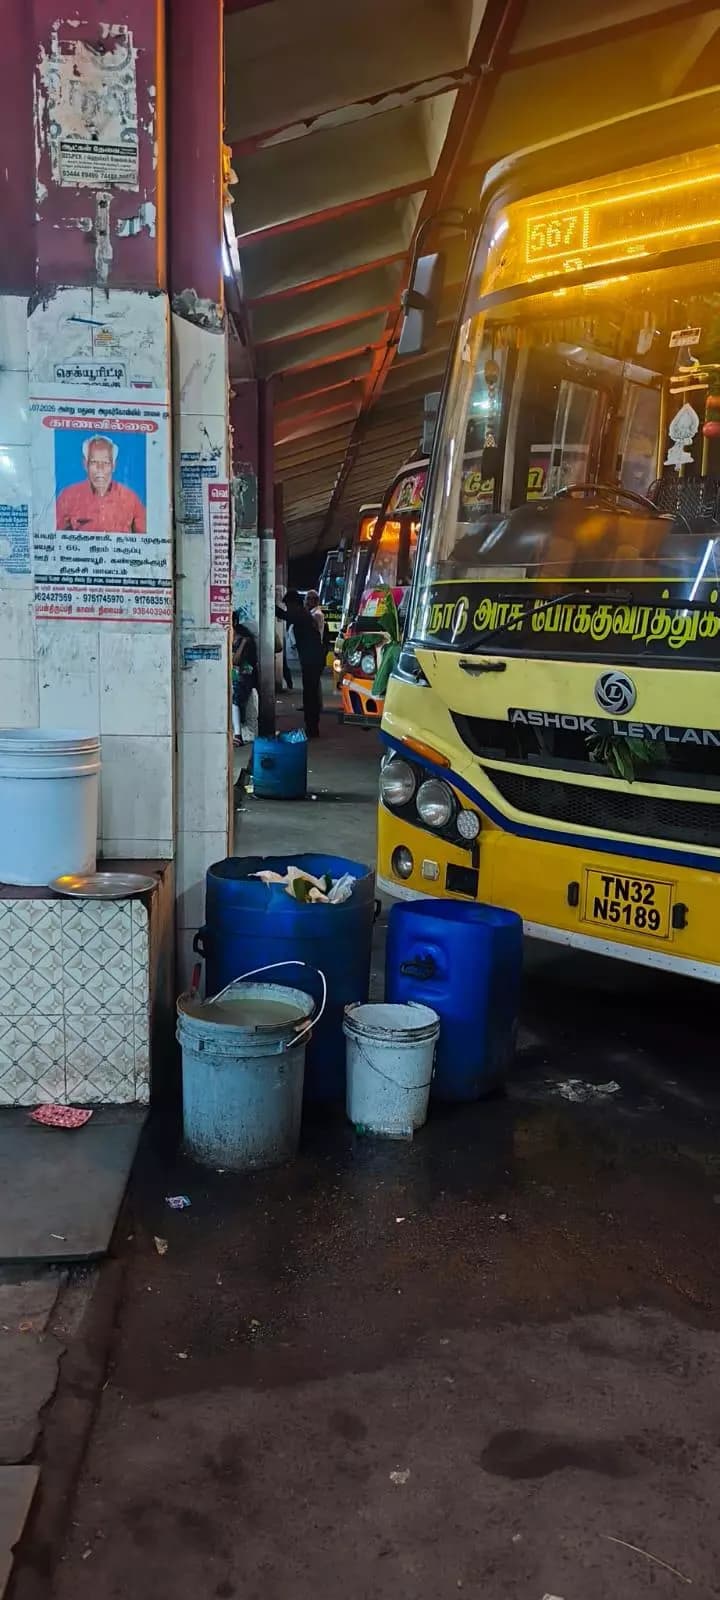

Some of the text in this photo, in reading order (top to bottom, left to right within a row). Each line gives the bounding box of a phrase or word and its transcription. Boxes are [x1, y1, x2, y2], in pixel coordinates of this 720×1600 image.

[531, 216, 577, 251] 567
[56, 365, 123, 381] செக்யூரிட்டி
[49, 418, 154, 432] காணவில்லை
[60, 566, 89, 575] திருச்சி
[83, 593, 125, 604] 9751745970
[511, 710, 720, 747] ASHOK LEYLAN
[601, 875, 656, 906] TN32
[593, 897, 661, 931] N5189
